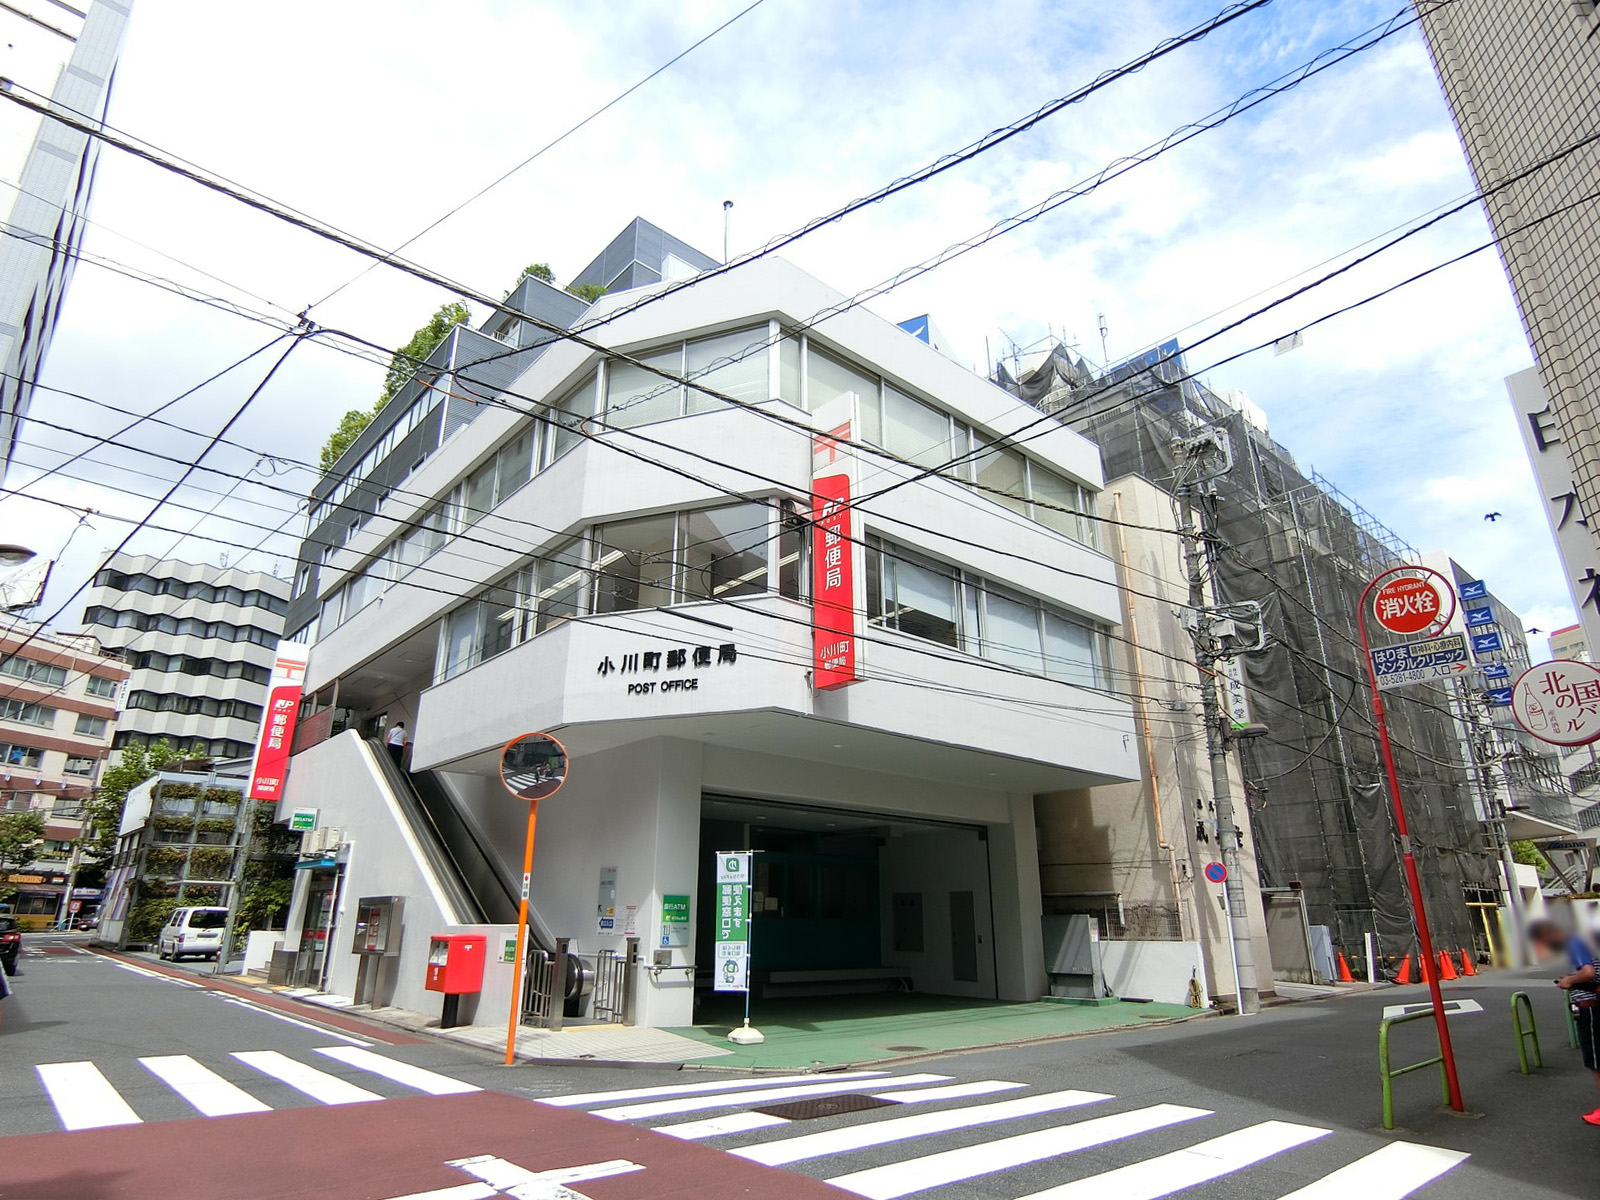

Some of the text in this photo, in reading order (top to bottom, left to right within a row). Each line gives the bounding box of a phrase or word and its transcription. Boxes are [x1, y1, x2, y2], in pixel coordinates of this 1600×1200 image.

[825, 524, 842, 591] 郵便局
[1382, 581, 1425, 595] FIRE HYDRANT
[1380, 590, 1436, 620] 消火栓
[820, 640, 849, 659] 小川町
[1374, 647, 1408, 663] はりま
[597, 643, 737, 676] 小川町郵便局
[1378, 649, 1464, 675] メンタルクリニック
[1380, 669, 1425, 686] 03-5281-4800
[1431, 664, 1451, 677] 入口
[628, 678, 698, 695] POST OFFICE
[268, 713, 287, 750] 郵便局
